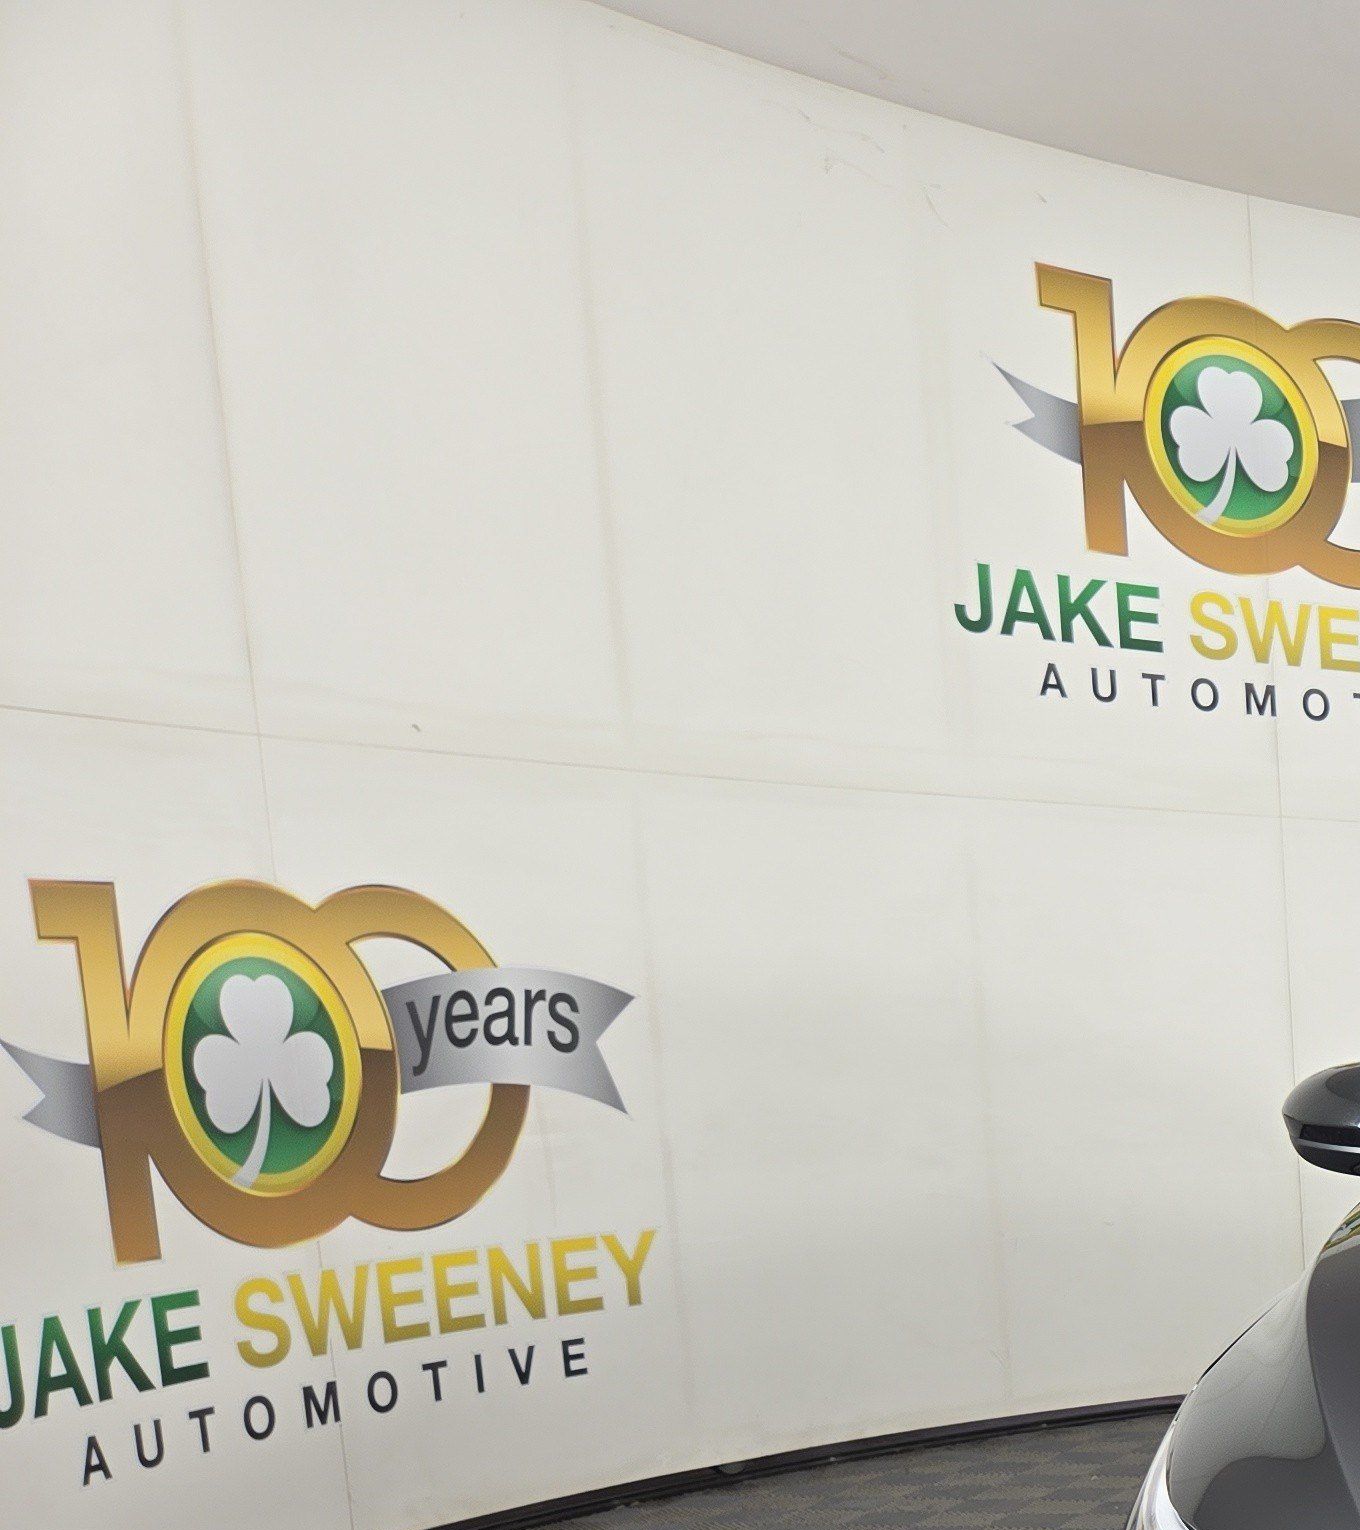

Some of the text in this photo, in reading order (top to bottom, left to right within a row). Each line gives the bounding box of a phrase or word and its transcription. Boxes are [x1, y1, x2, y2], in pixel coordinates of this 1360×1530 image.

[954, 562, 1164, 653] JAKE
[27, 878, 580, 1265] 100 years
[233, 1230, 656, 1369] SWEENEY
[82, 1337, 589, 1487] AUTOMOTIVE
